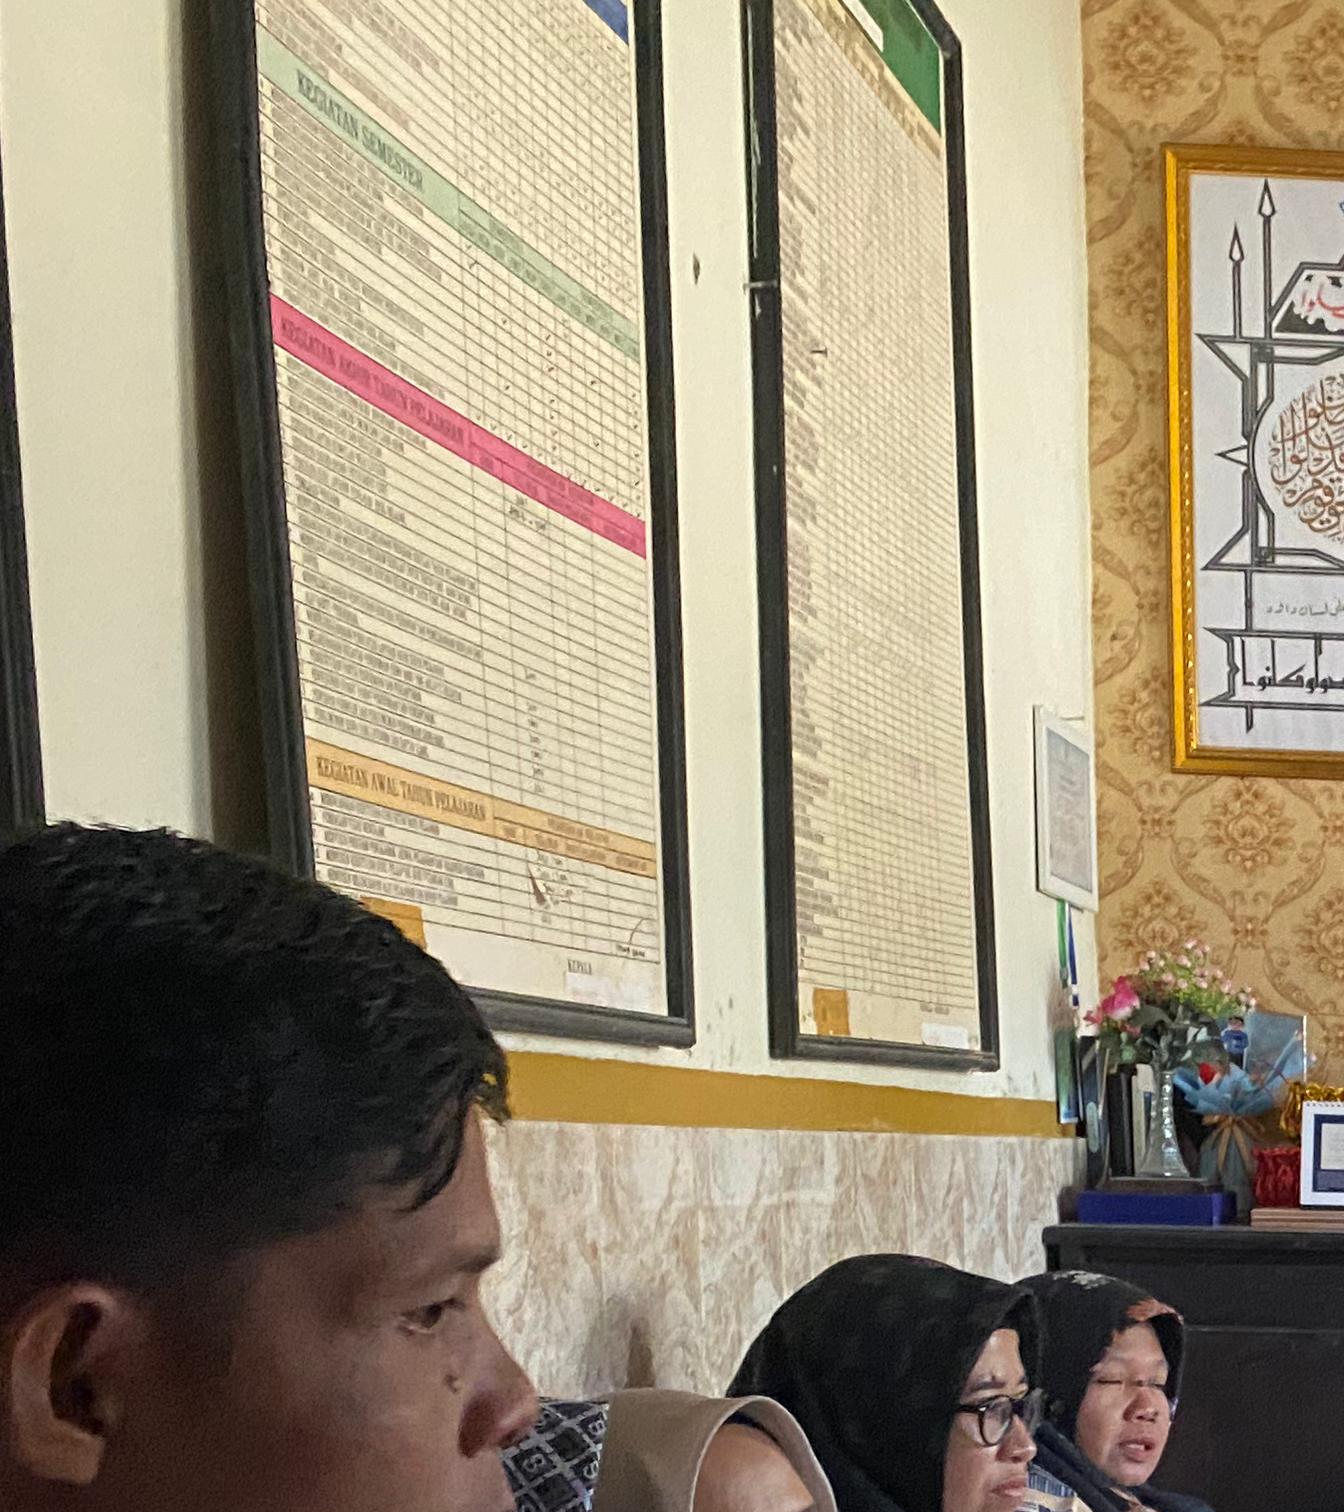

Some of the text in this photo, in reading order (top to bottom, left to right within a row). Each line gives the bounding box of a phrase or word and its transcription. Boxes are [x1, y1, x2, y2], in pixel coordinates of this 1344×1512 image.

[296, 68, 424, 193] KEGIATAN SEMESTER
[316, 756, 368, 789] KEGIATAN
[371, 772, 399, 798] AWAL
